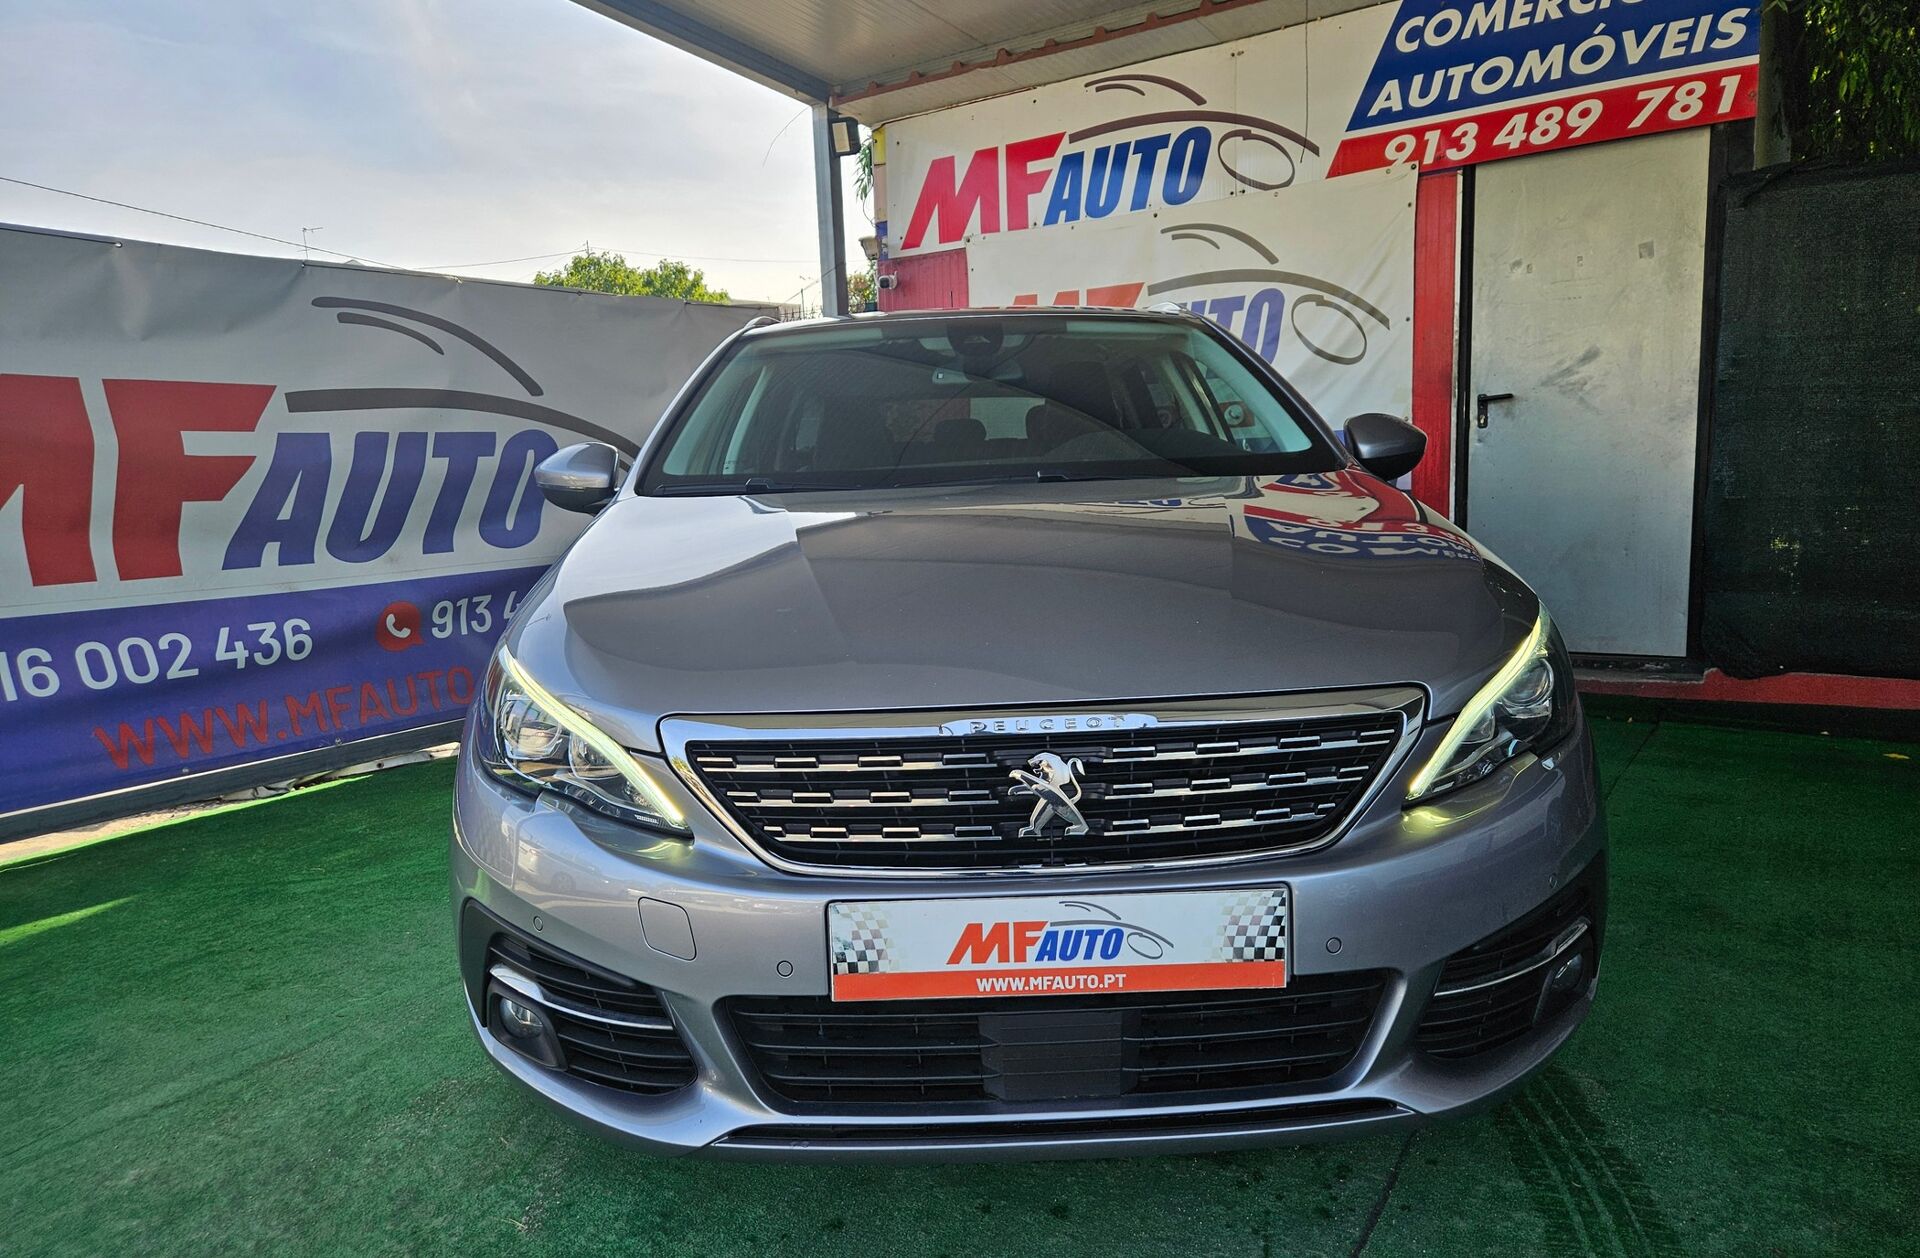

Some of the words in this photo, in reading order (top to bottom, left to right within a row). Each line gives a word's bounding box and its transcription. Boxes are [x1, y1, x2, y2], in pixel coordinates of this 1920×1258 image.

[1367, 7, 1751, 117] AUTOMÓVEIS
[1384, 121, 1479, 169] 913
[1493, 98, 1604, 150] 489
[1627, 73, 1742, 130] 781
[431, 594, 493, 640] 913
[74, 632, 200, 691] 002
[215, 618, 314, 670] 436
[969, 713, 1126, 735] PEUGEOT
[975, 972, 1127, 993] WWW.MFAUTO.PT
